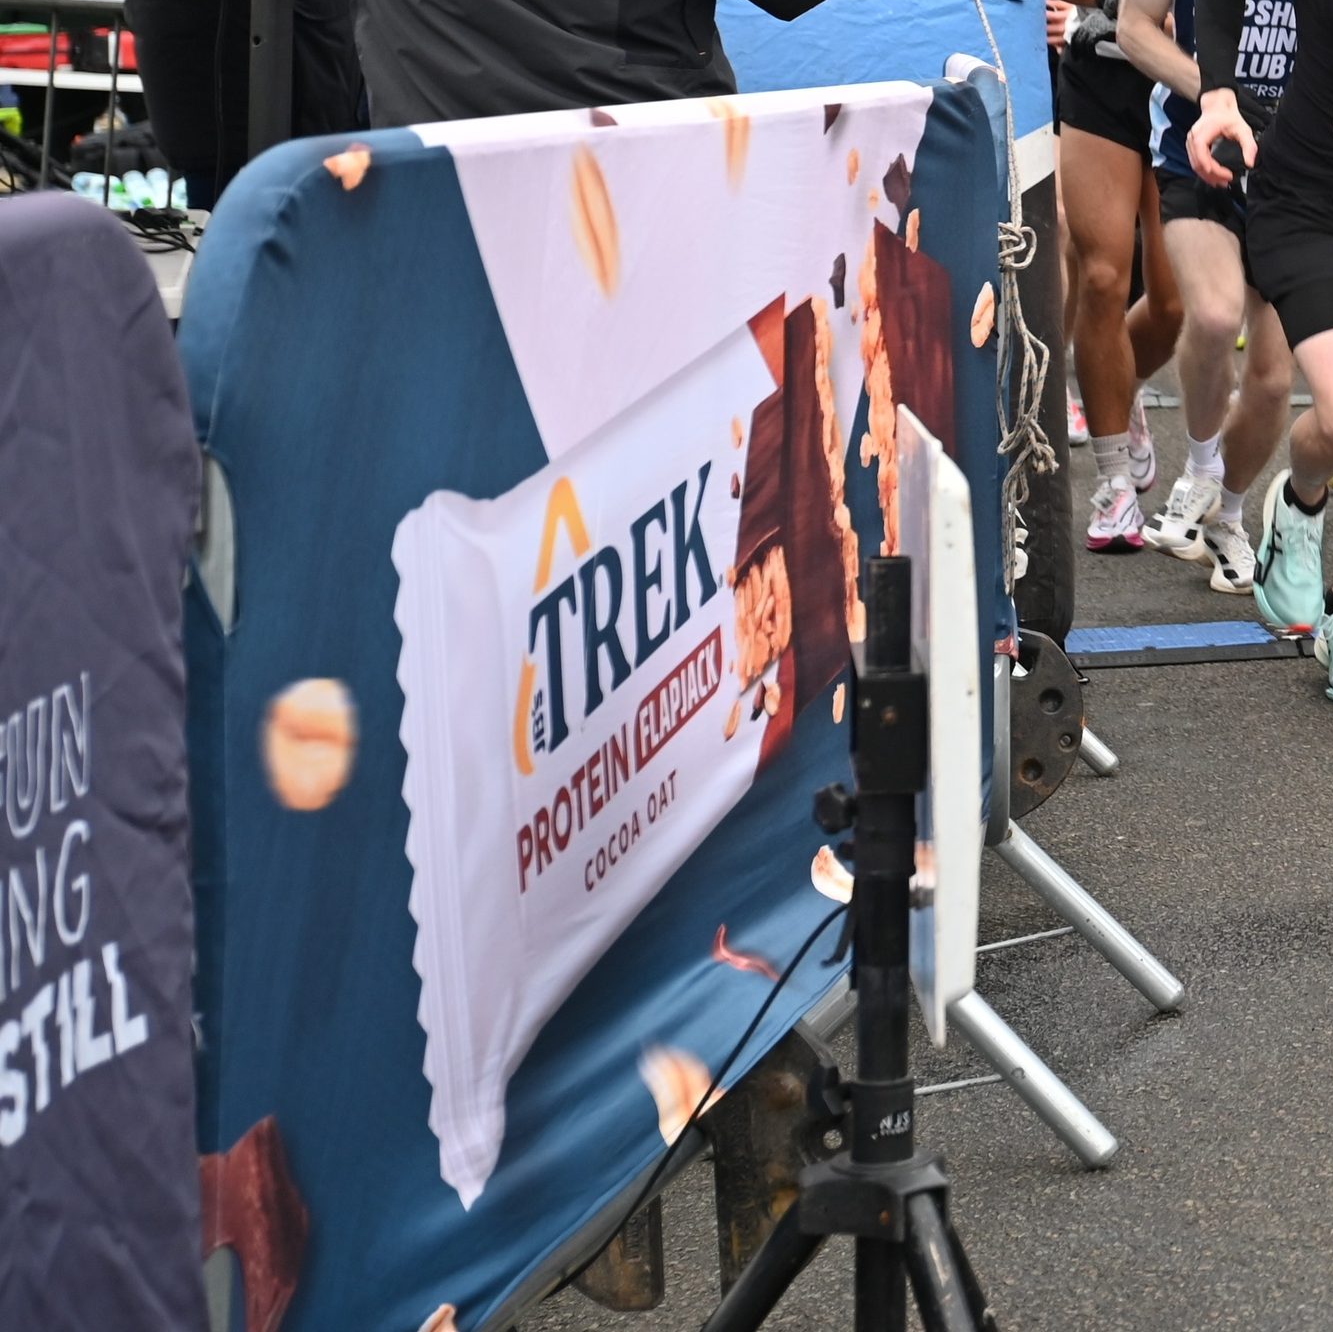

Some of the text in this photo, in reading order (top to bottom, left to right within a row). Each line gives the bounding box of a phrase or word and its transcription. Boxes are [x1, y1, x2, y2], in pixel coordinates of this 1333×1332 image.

[1235, 53, 1287, 79] LUB
[528, 460, 717, 753] TREK
[0, 671, 91, 839] UN
[516, 638, 718, 894] PROTEIN FLAPJACK
[584, 770, 677, 893] COCOA OAT
[0, 942, 148, 1146] STILL
